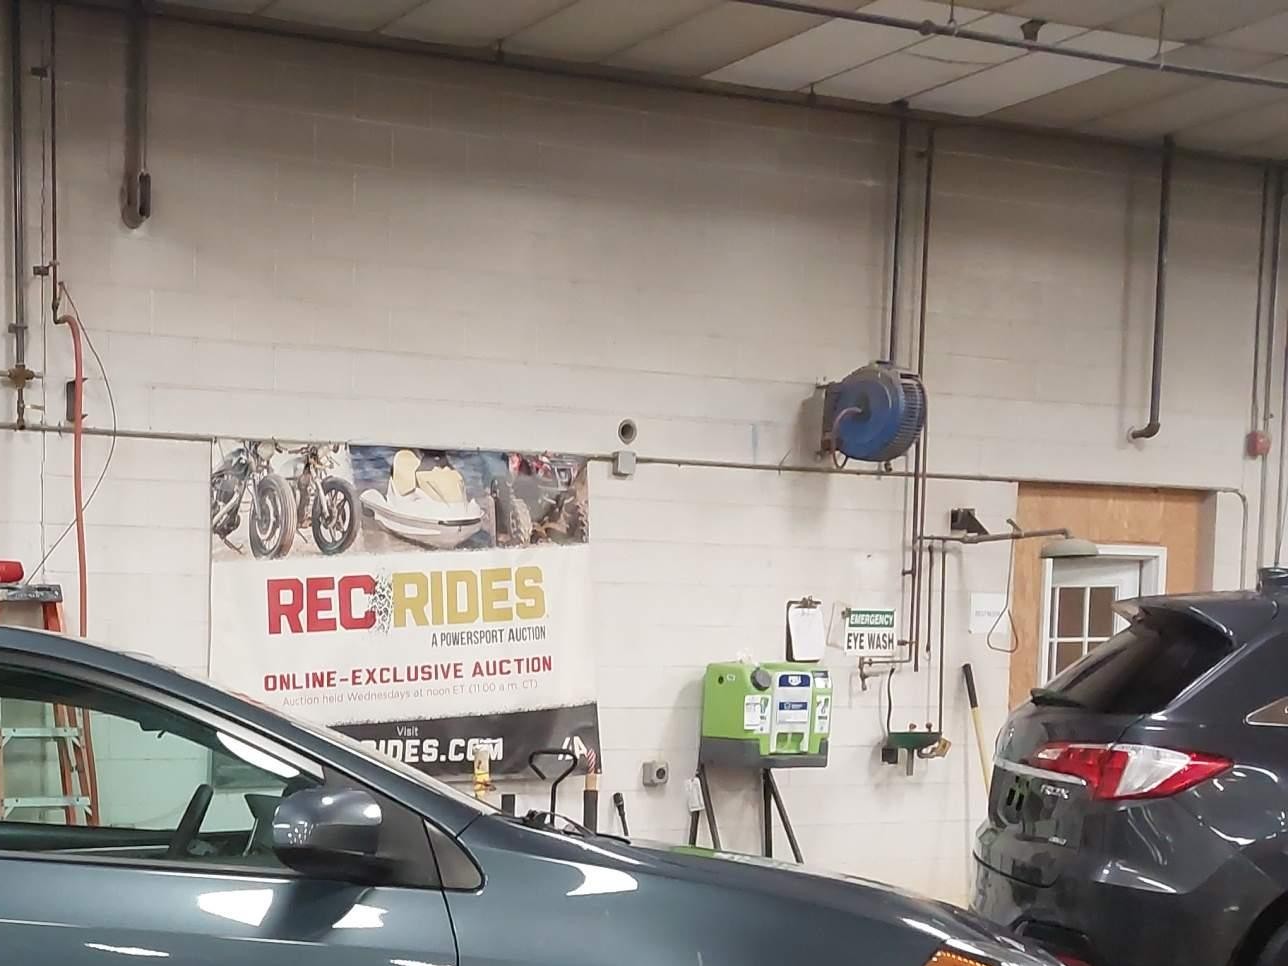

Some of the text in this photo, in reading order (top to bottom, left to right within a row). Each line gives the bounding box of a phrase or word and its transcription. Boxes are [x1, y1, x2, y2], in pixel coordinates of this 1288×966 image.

[267, 566, 546, 634] REC RIDES
[850, 613, 894, 626] EMERGENCY
[431, 625, 546, 648] A POWERSPORT AUCTION
[846, 632, 894, 650] EYE WASH
[264, 656, 552, 692] ONLINE-EXCLUSIVE AUCTION
[282, 692, 318, 706] Auction
[322, 692, 344, 704] held
[347, 687, 410, 702] Wednesdays
[413, 688, 423, 698] at
[426, 687, 450, 697] noon
[453, 684, 464, 695] ET
[396, 725, 419, 737] Visit
